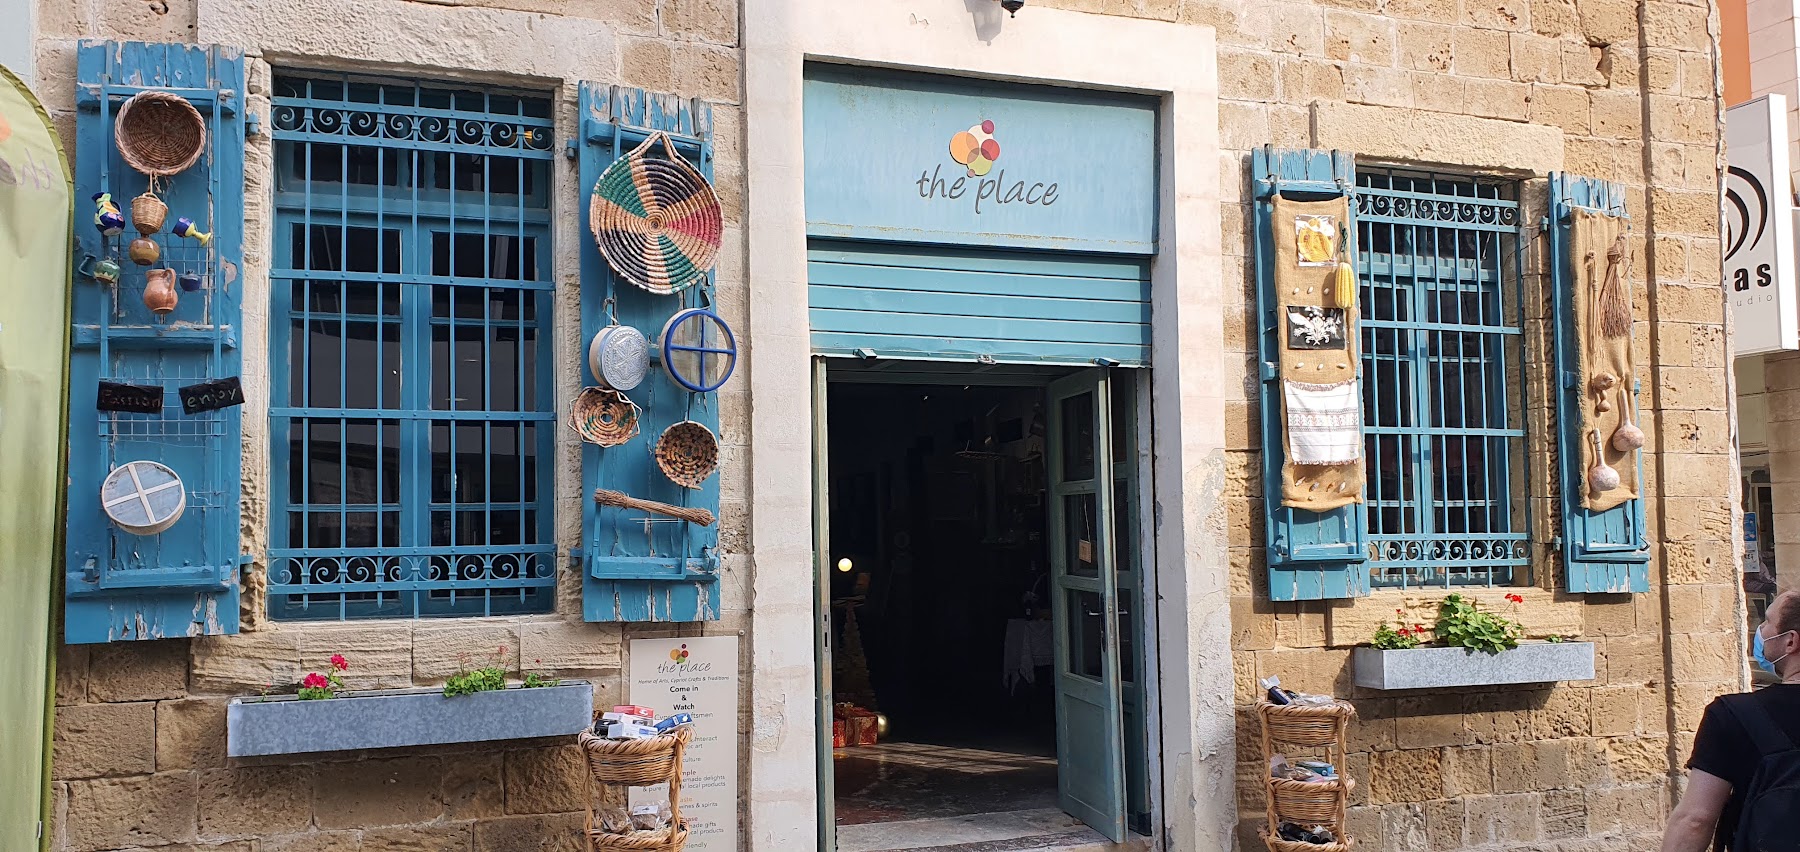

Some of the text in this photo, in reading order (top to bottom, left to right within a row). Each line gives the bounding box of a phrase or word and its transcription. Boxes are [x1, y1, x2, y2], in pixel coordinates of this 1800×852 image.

[916, 163, 1060, 215] the place
[1724, 263, 1772, 292] as
[1736, 294, 1773, 307] udio
[187, 387, 237, 408] enjoy
[657, 660, 712, 677] the place
[669, 685, 691, 693] Come
[673, 703, 695, 711] Watch
[703, 775, 726, 783] delights
[699, 828, 724, 836] products
